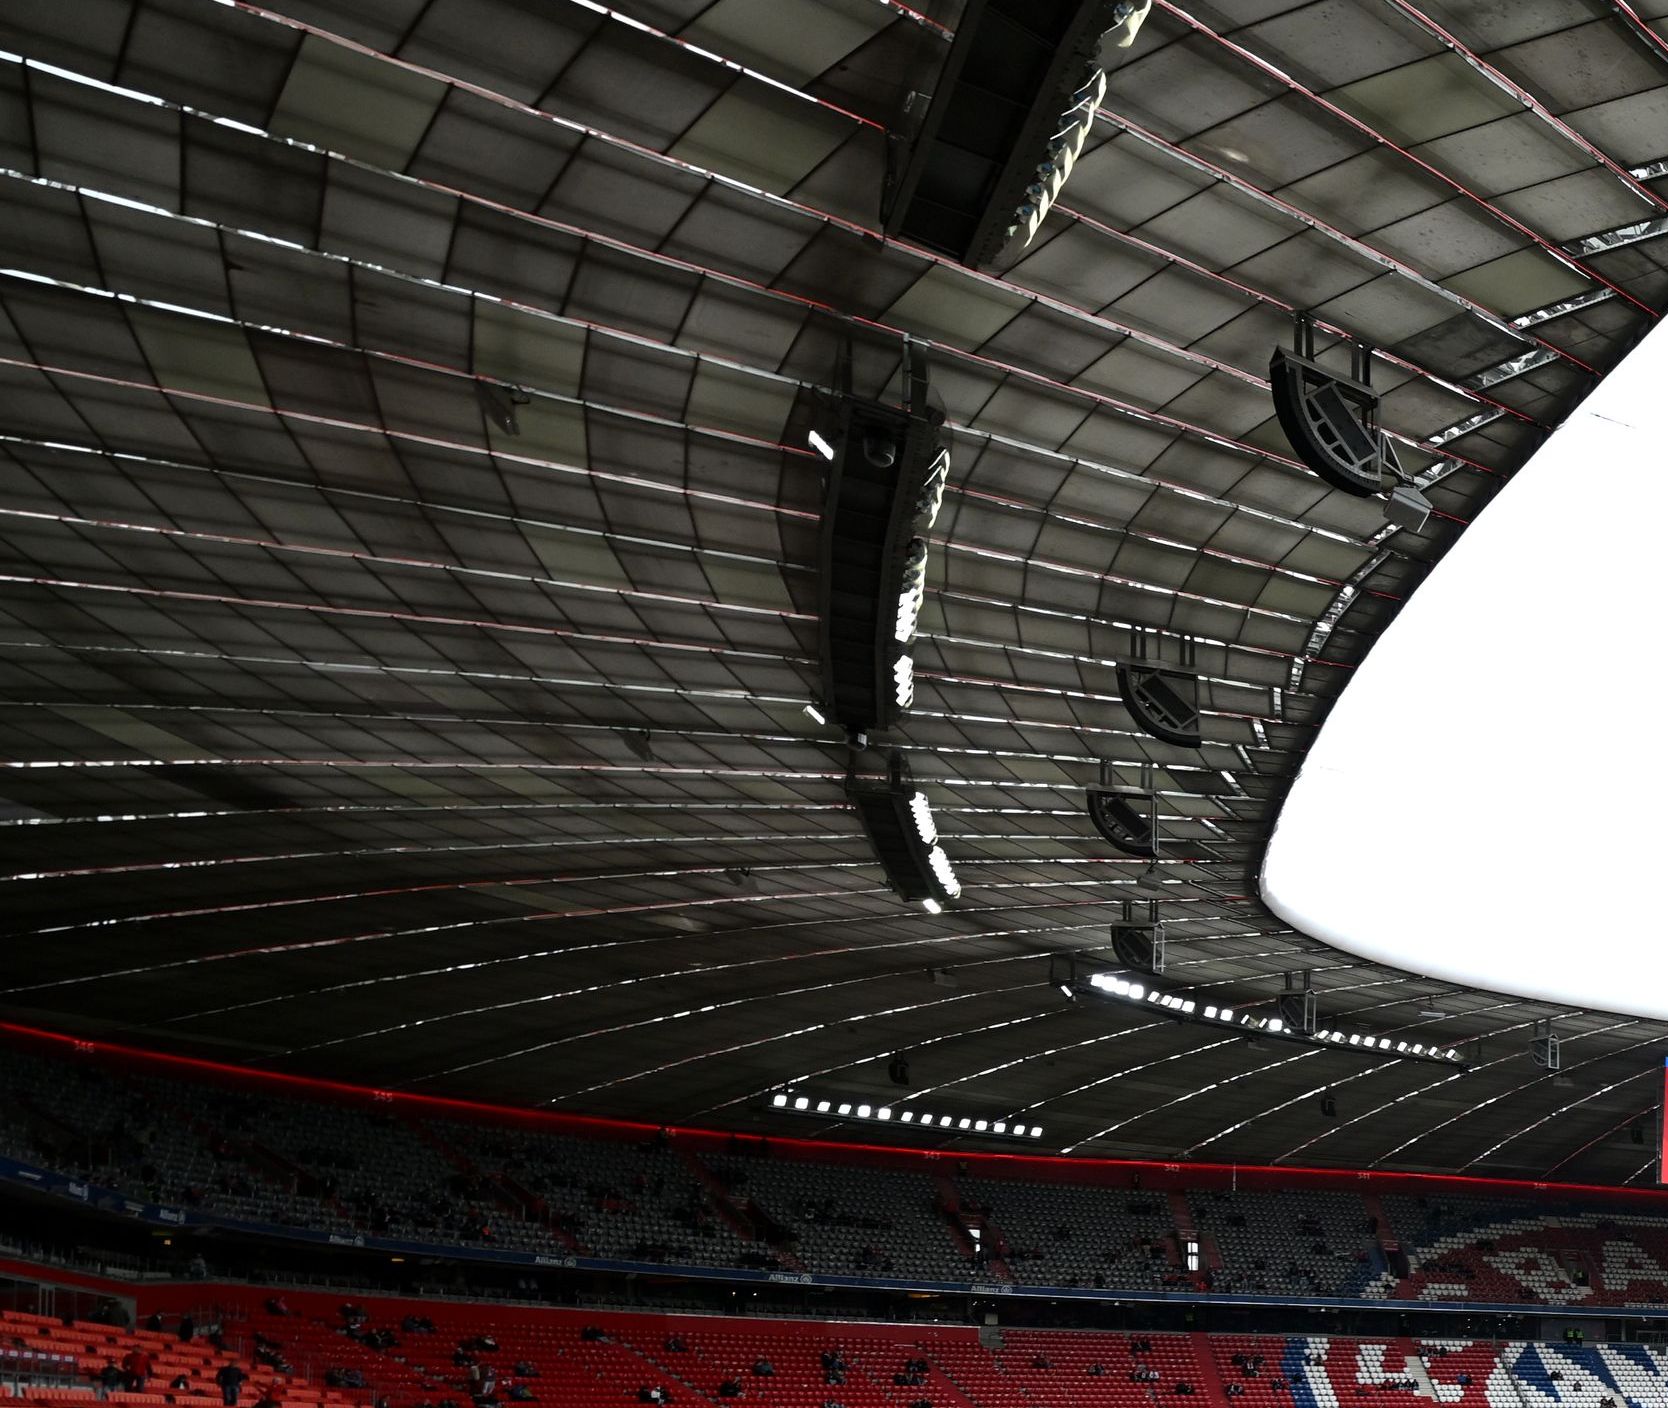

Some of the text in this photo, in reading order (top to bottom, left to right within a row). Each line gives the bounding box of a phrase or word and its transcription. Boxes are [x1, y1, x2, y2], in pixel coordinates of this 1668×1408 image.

[534, 1256, 563, 1266] Allianz
[768, 1273, 799, 1283] Allianz
[970, 1284, 999, 1293] Allianz
